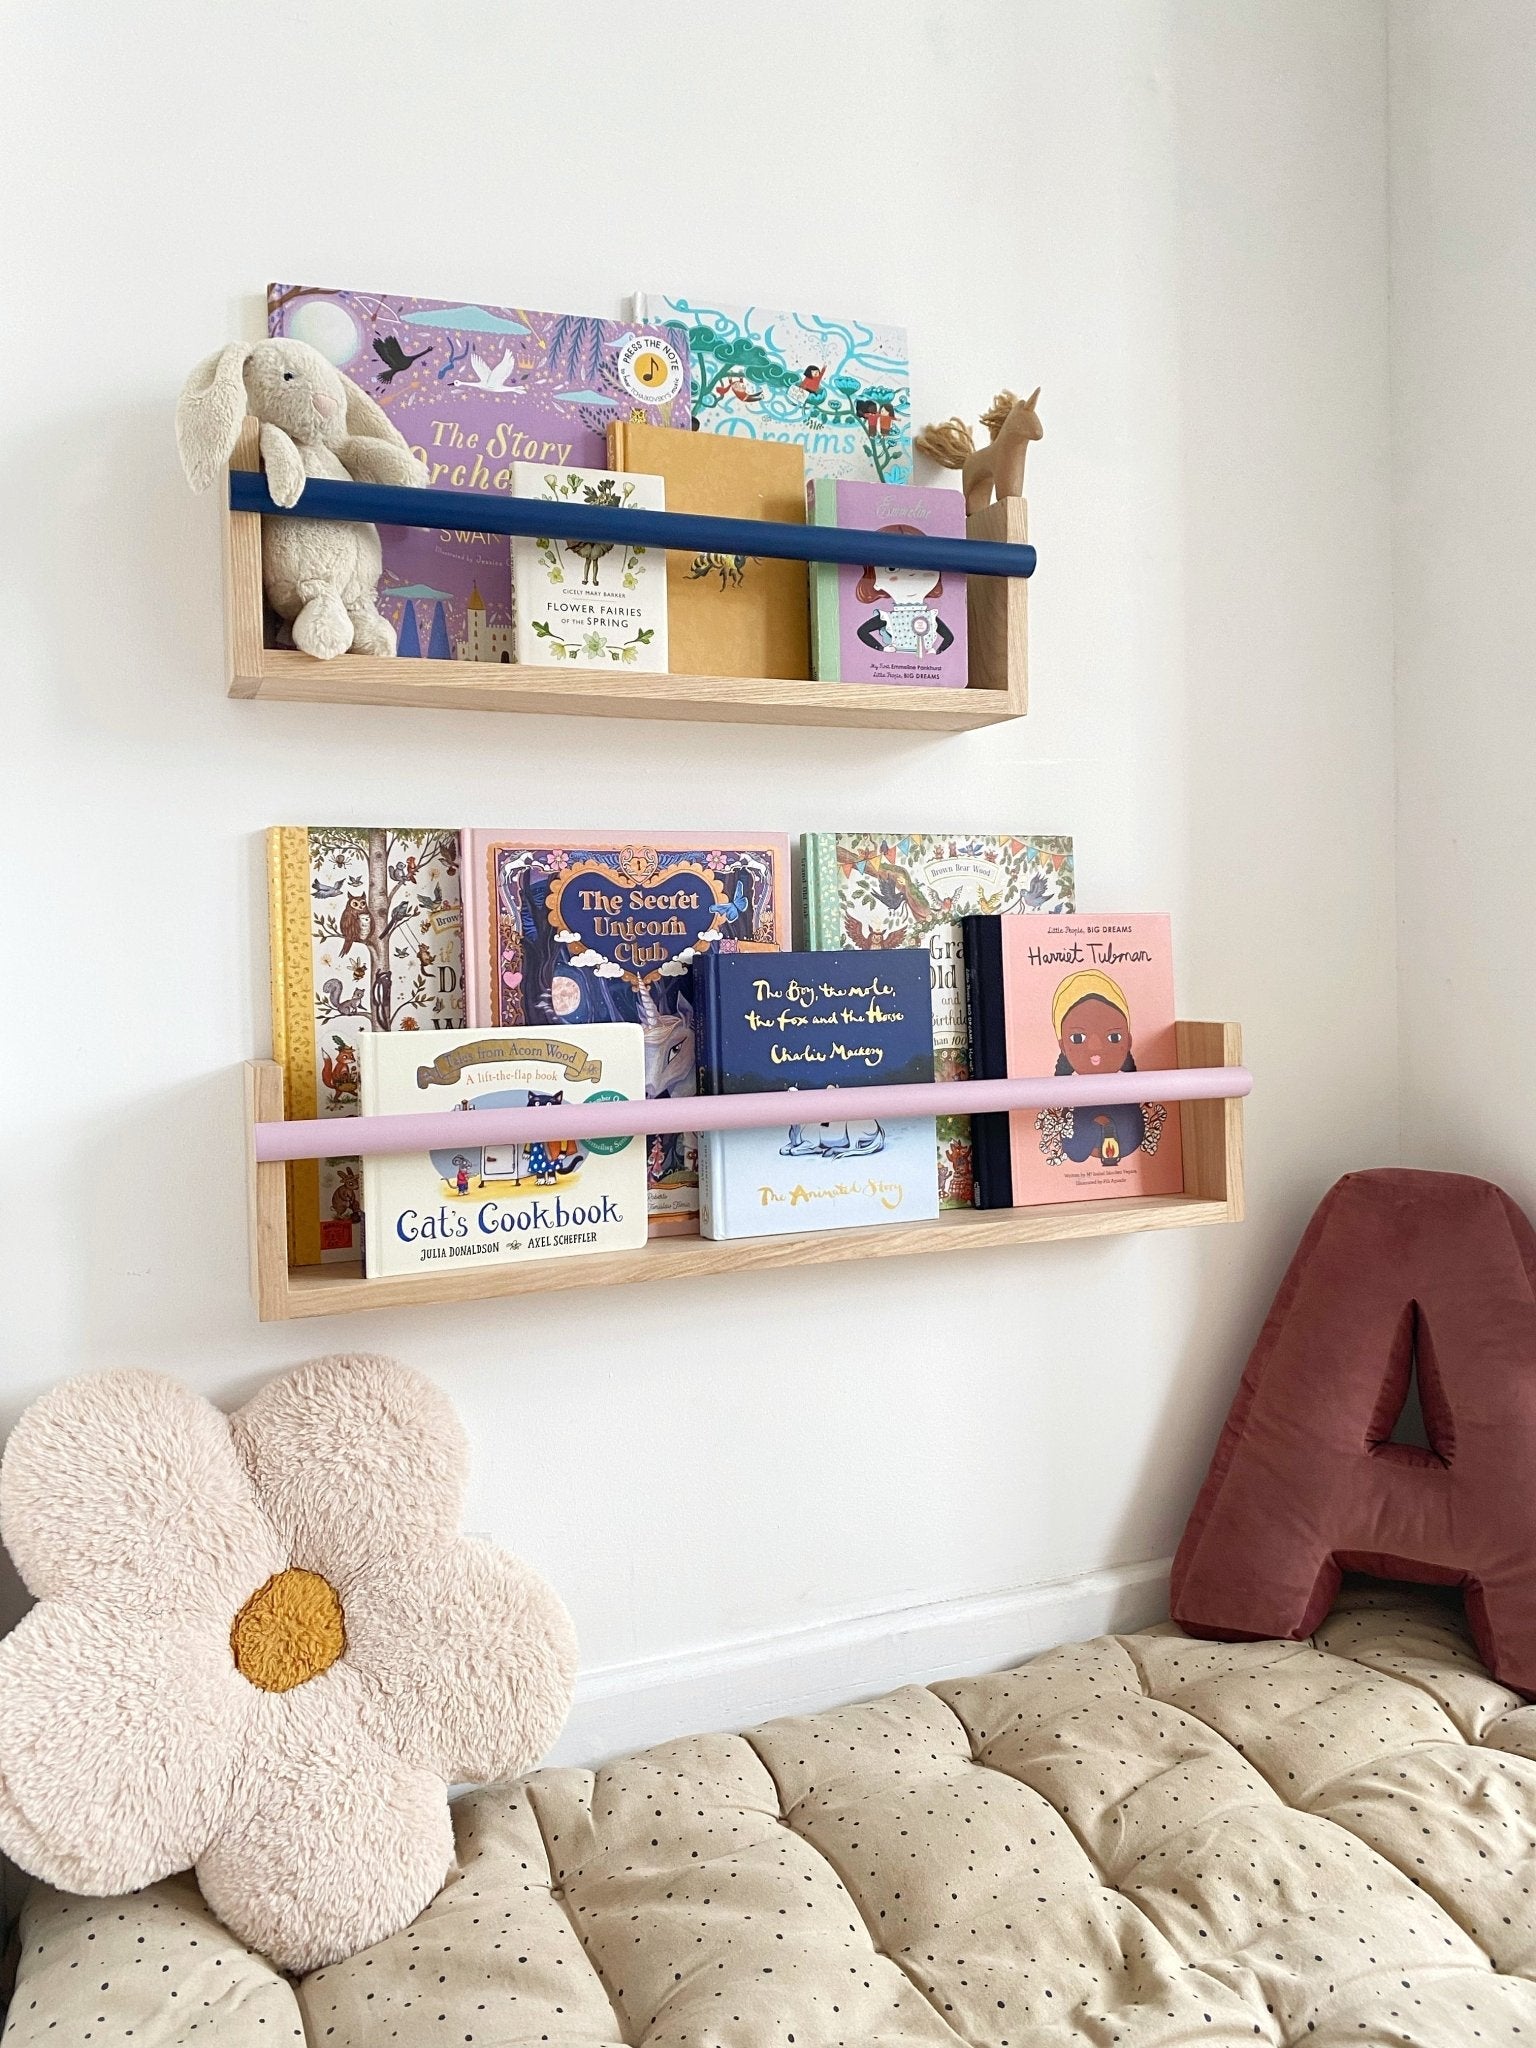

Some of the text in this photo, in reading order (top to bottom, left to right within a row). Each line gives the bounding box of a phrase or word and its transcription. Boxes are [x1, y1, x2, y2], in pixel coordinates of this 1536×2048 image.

[622, 338, 680, 371] PRESS THE NOTE
[430, 420, 479, 449] The
[486, 422, 573, 466] Story
[875, 495, 931, 520] Emmeline
[562, 588, 583, 596] CICELY
[603, 591, 626, 599] BARKER
[547, 602, 642, 617] FLOWER FAIRIES
[586, 616, 629, 628] SPRING
[930, 863, 991, 878] Brown Bear Wood
[578, 889, 700, 916] The Secret
[593, 915, 688, 941] Unicorn
[1047, 926, 1064, 934] Little
[1102, 925, 1133, 933] DREAMS
[614, 942, 669, 968] Club
[1027, 941, 1152, 966] Harriet Tubman
[438, 965, 463, 993] D
[752, 977, 896, 1008] The Boy, the mole,
[941, 991, 961, 1006] and
[744, 996, 904, 1032] the fox and the Horse
[443, 1042, 578, 1069] Tales from Acorn Wood
[770, 1041, 884, 1067] Charlie Mackesy
[466, 1068, 558, 1085] A lift-the-flap book
[757, 1178, 903, 1210] The Animated Story
[396, 1205, 468, 1243] Cat's
[477, 1195, 624, 1235] Cookbook
[419, 1231, 598, 1261] JULIA DONALDSON AXEL SCHEFFLER
